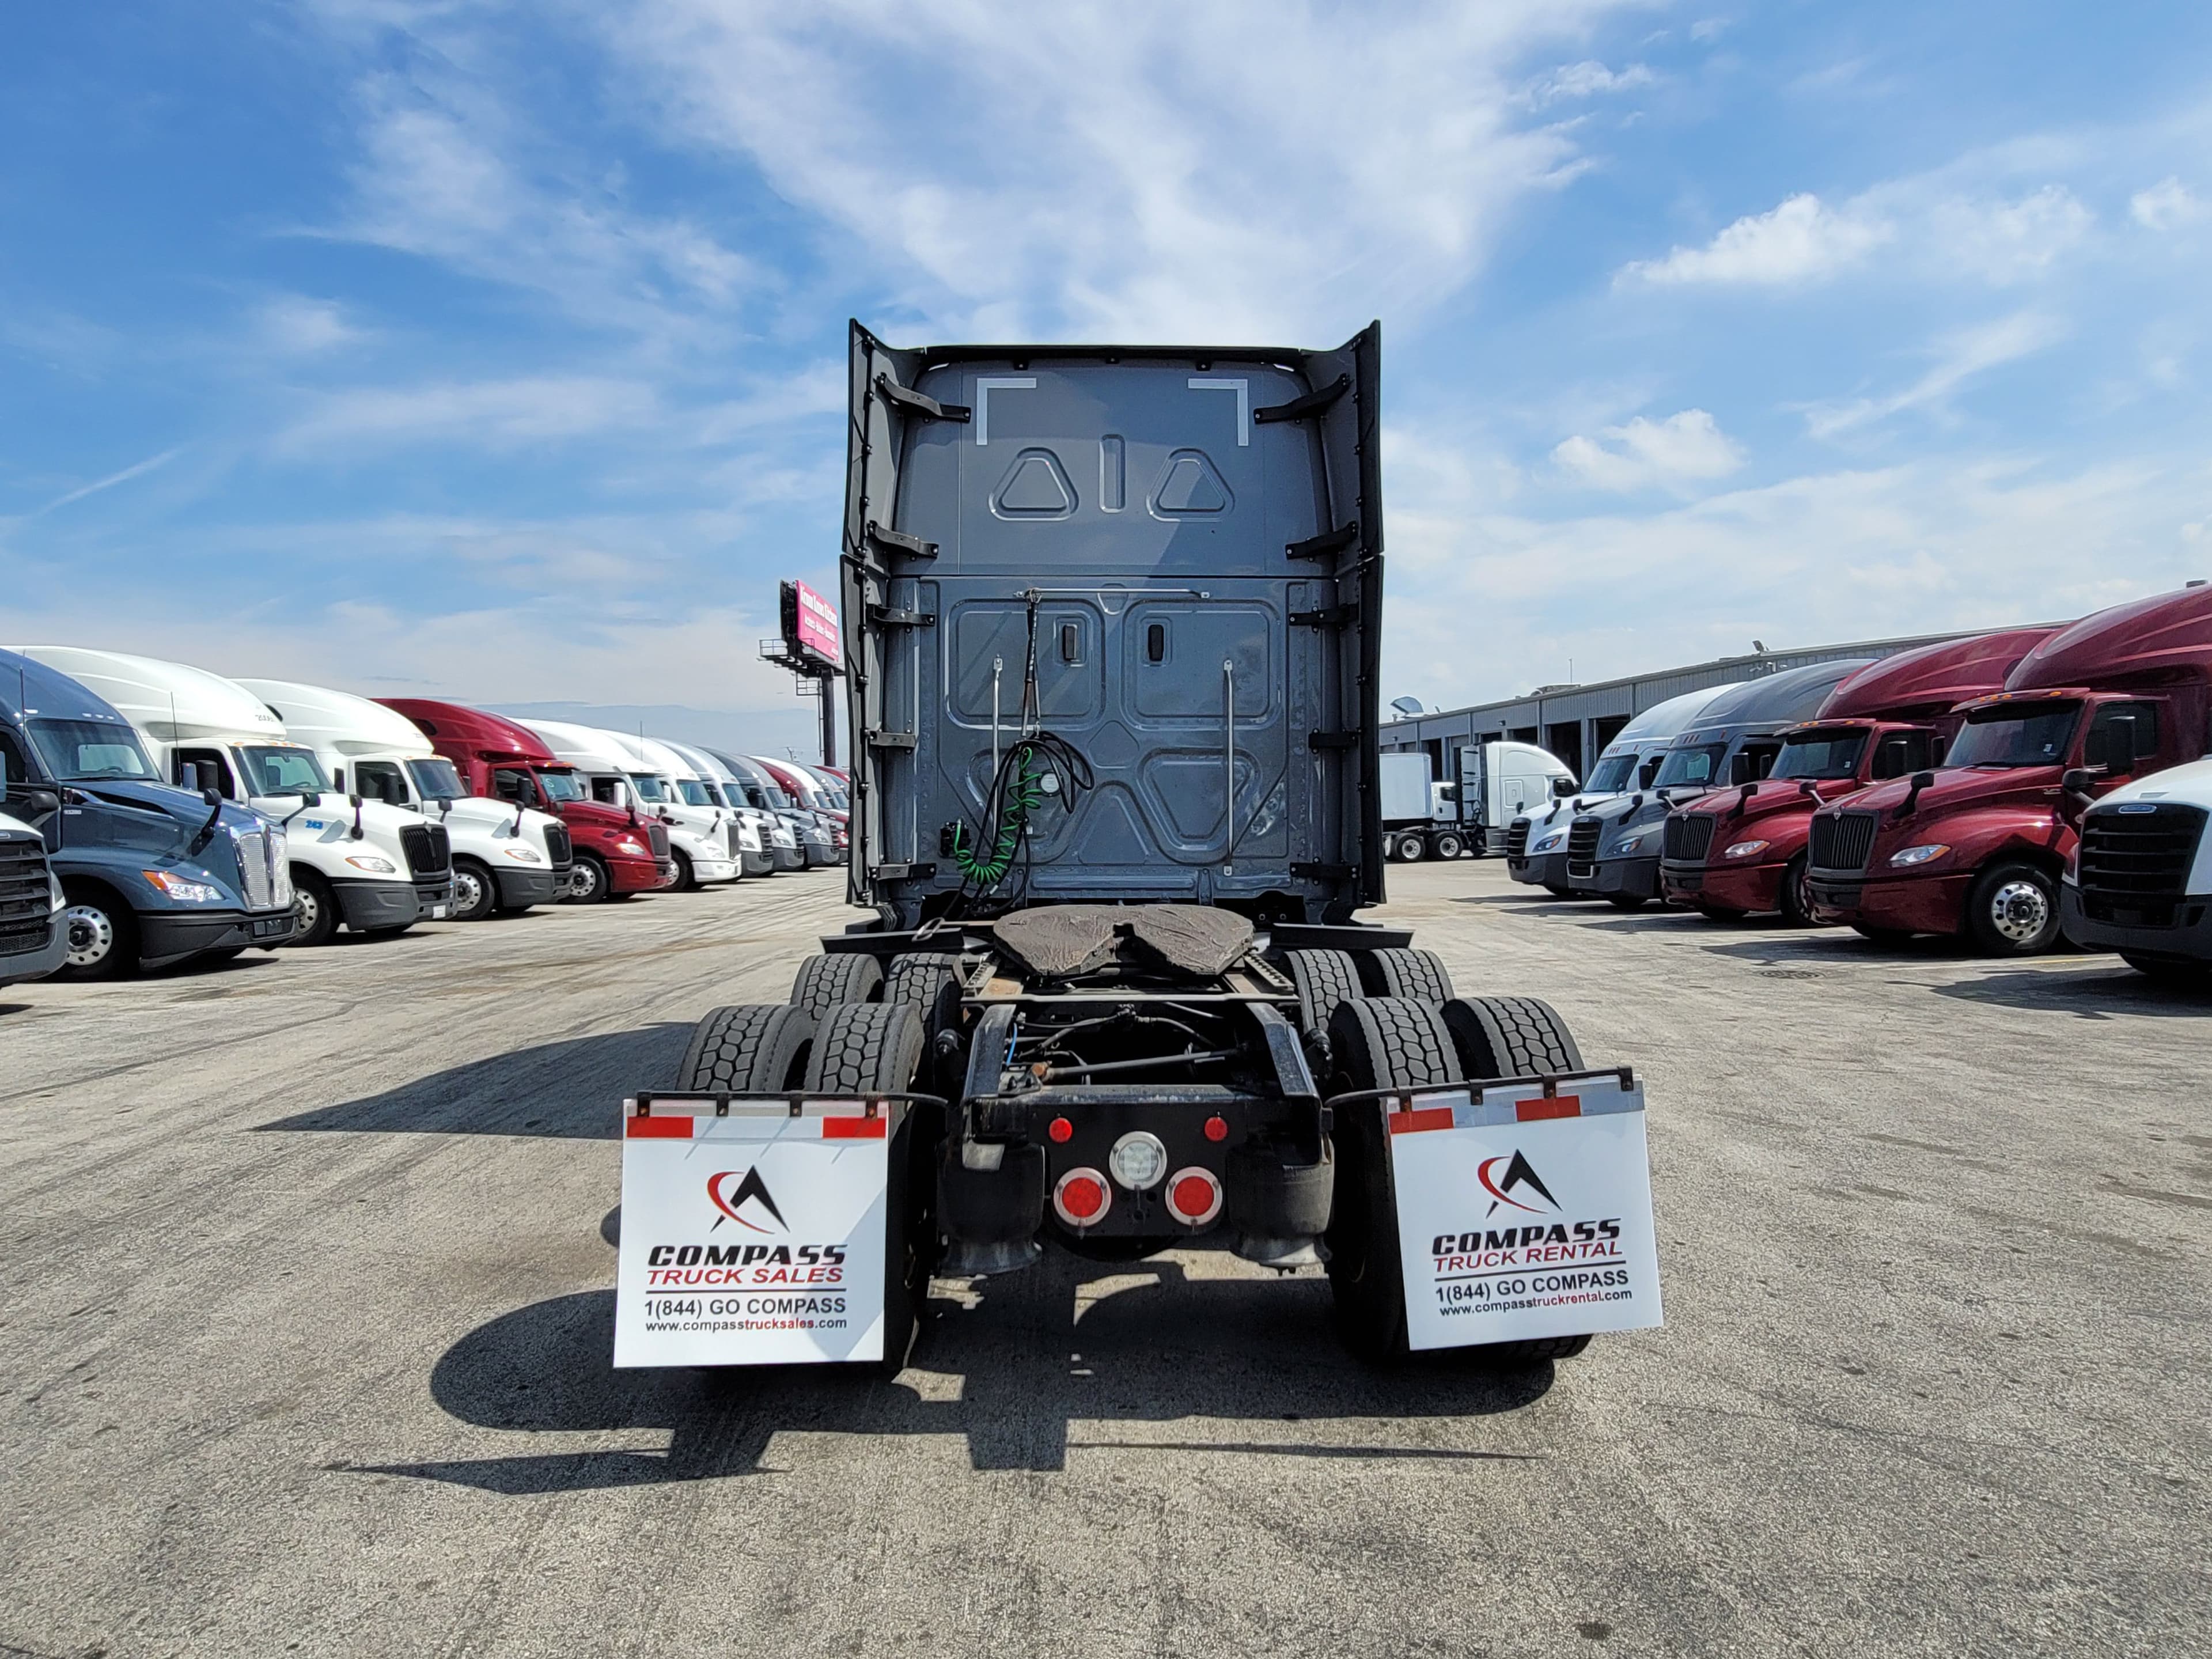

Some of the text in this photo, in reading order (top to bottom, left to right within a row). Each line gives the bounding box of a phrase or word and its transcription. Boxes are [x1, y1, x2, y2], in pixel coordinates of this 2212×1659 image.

[1431, 1218, 1621, 1255] COMPASS
[648, 1245, 848, 1266] COMPASS
[1433, 1241, 1623, 1272] TRUCK RENTAL
[647, 1267, 844, 1285] TRUCK SALES
[1435, 1270, 1629, 1306] 1(844) GO COMPASS
[644, 1297, 847, 1320] 1(844) GO COMPASS
[1440, 1289, 1633, 1317] www.compasstruckrental.com
[645, 1317, 847, 1333] www.compasstrucksales.com
